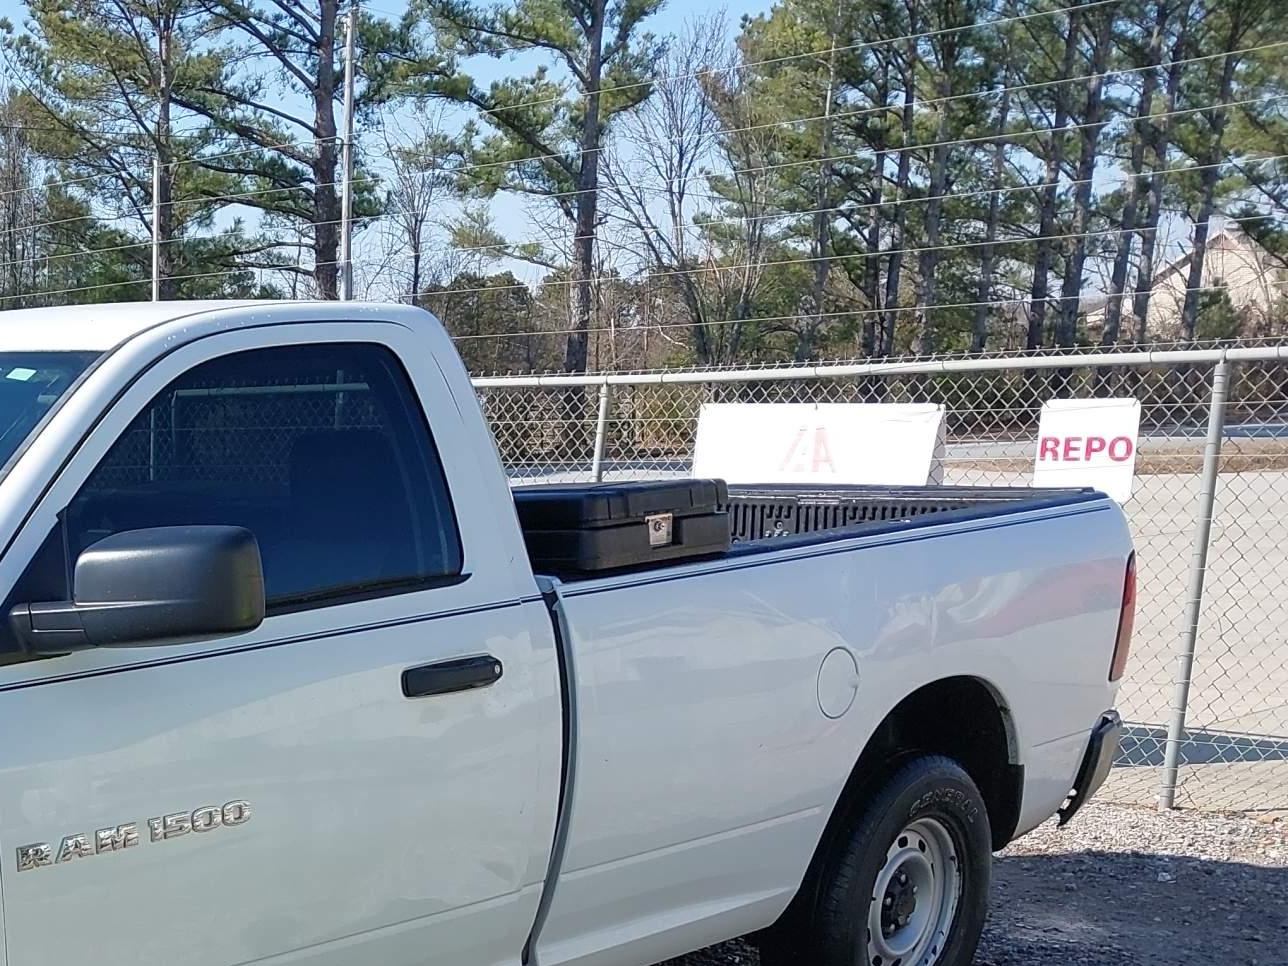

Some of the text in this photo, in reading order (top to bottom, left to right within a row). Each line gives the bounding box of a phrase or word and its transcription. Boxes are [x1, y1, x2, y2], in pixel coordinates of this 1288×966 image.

[1039, 436, 1133, 462] REPO
[15, 798, 253, 872] RAM 1500
